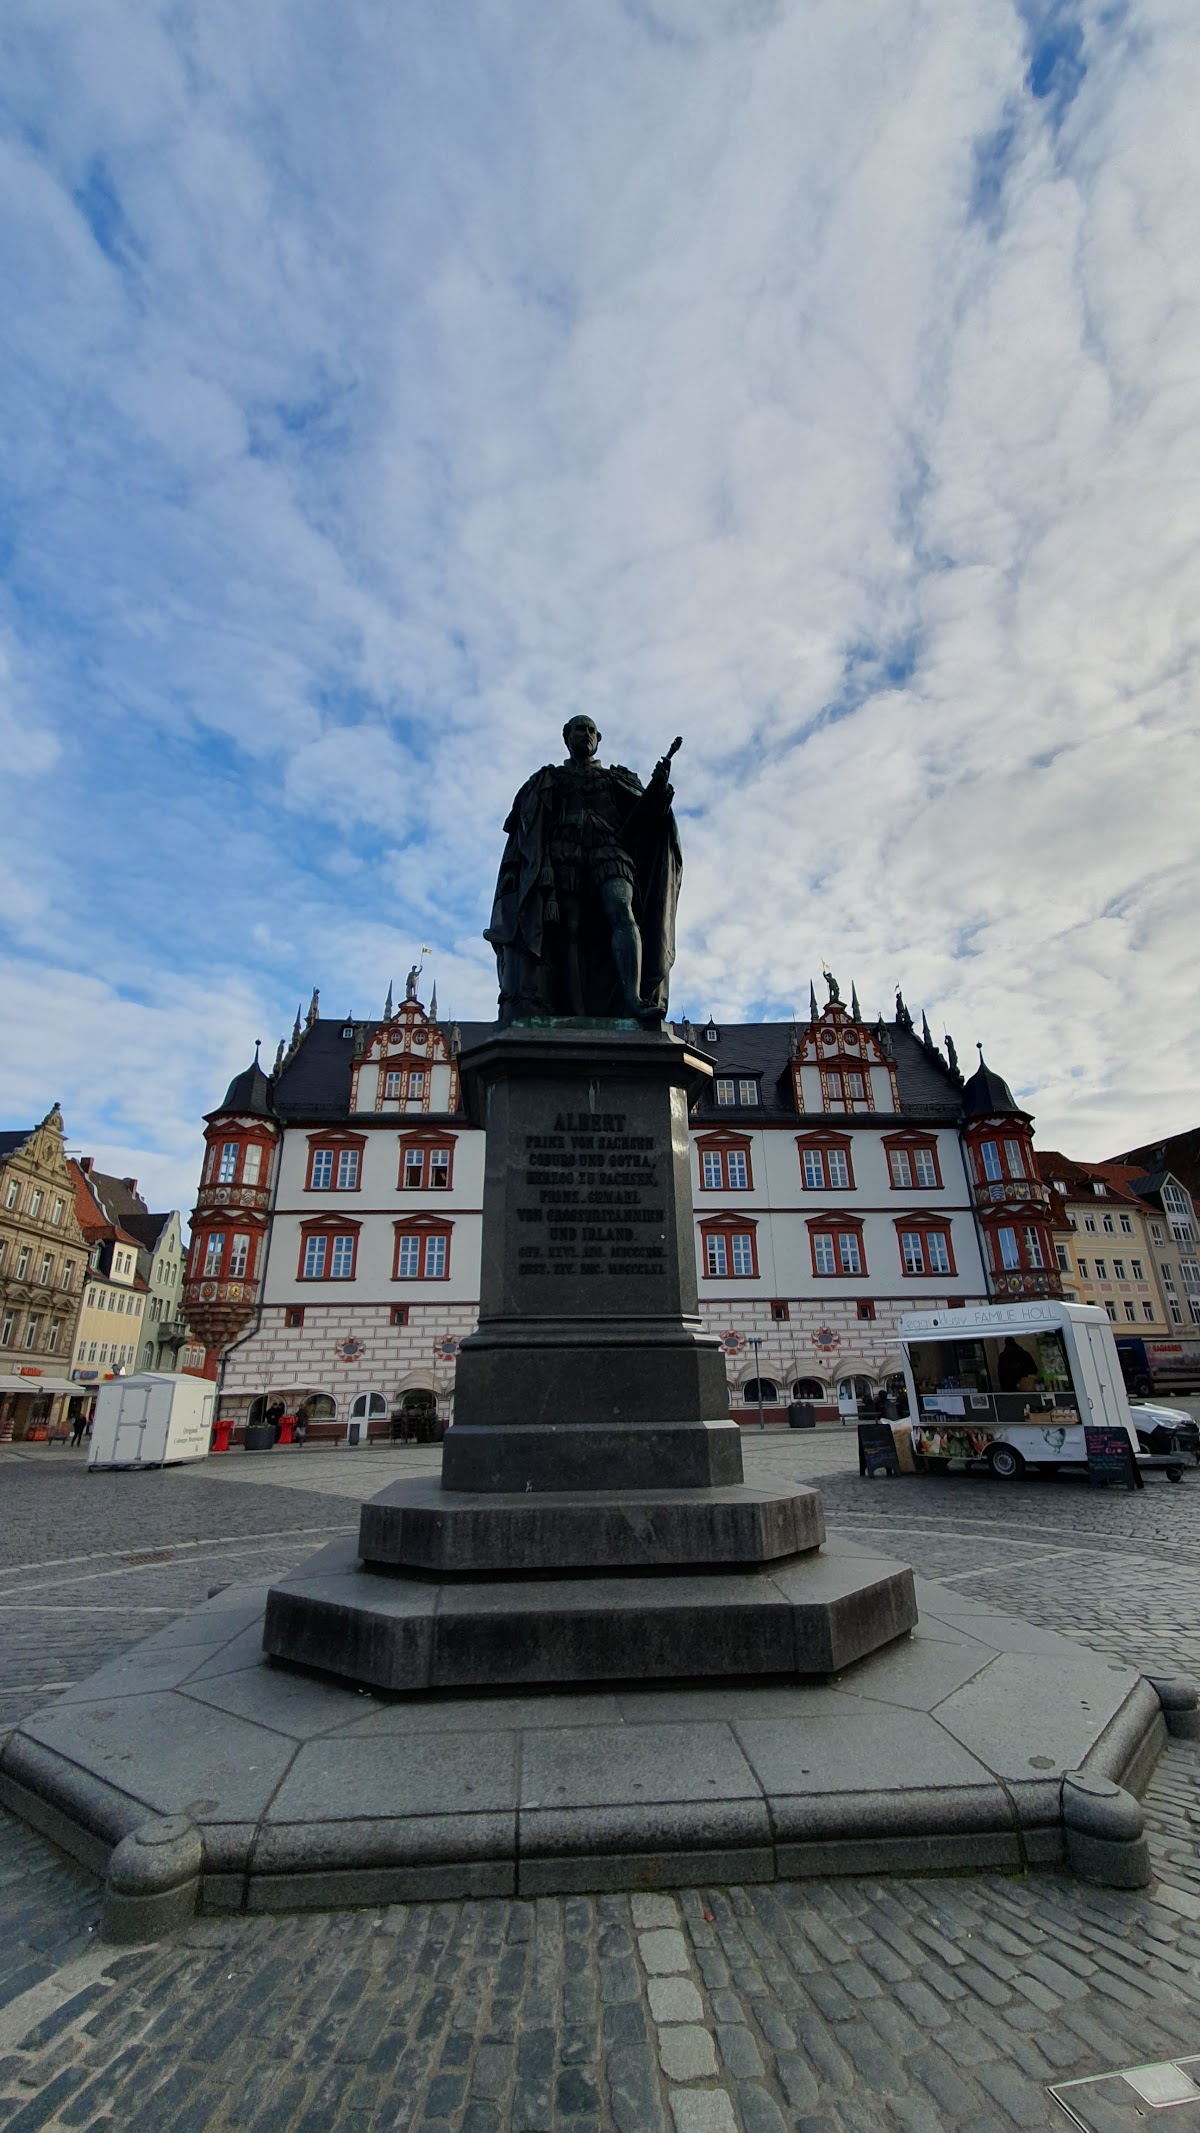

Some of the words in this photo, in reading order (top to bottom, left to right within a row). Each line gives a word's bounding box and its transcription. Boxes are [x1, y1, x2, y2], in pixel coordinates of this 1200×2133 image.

[554, 1113, 626, 1131] ALBERT
[571, 1136, 594, 1149] VON
[598, 1136, 655, 1150] SACHSEN
[580, 1154, 604, 1167] UND
[517, 1209, 542, 1222] VON
[550, 1228, 577, 1241] UND
[974, 1309, 1016, 1325] FAMILIE
[1021, 1306, 1057, 1321] HOLL
